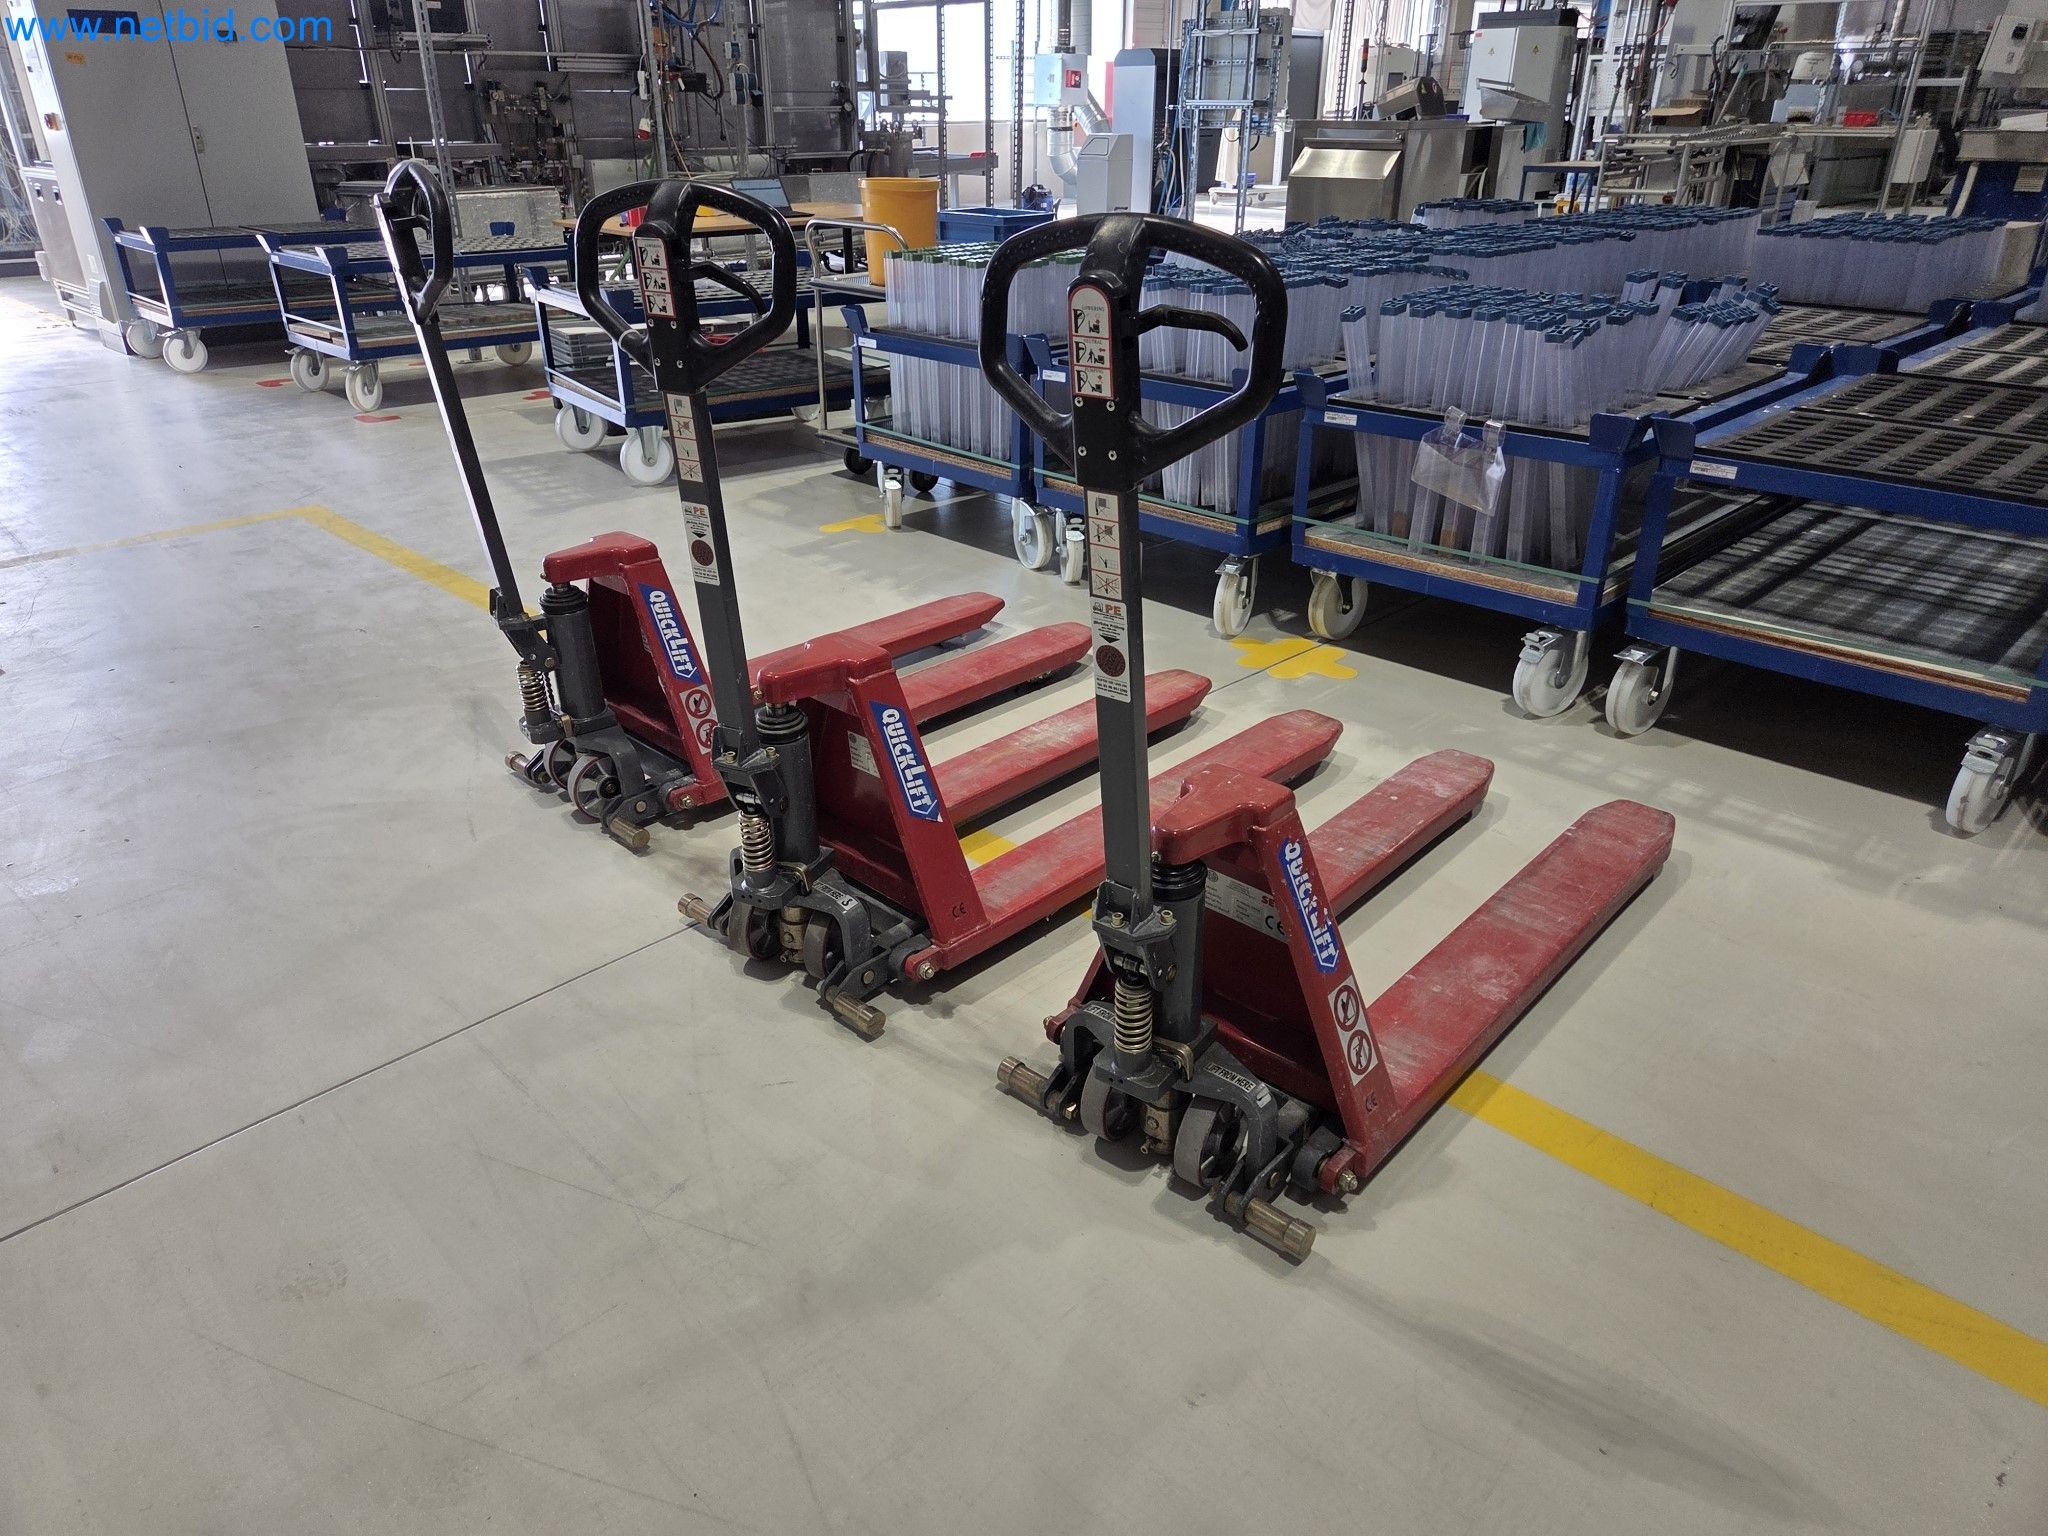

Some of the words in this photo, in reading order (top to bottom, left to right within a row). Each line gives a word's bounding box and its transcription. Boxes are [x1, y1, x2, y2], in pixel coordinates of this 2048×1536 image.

[1105, 604, 1122, 615] PE
[1219, 1069, 1238, 1081] FROM
[1235, 1077, 1254, 1091] HERE
